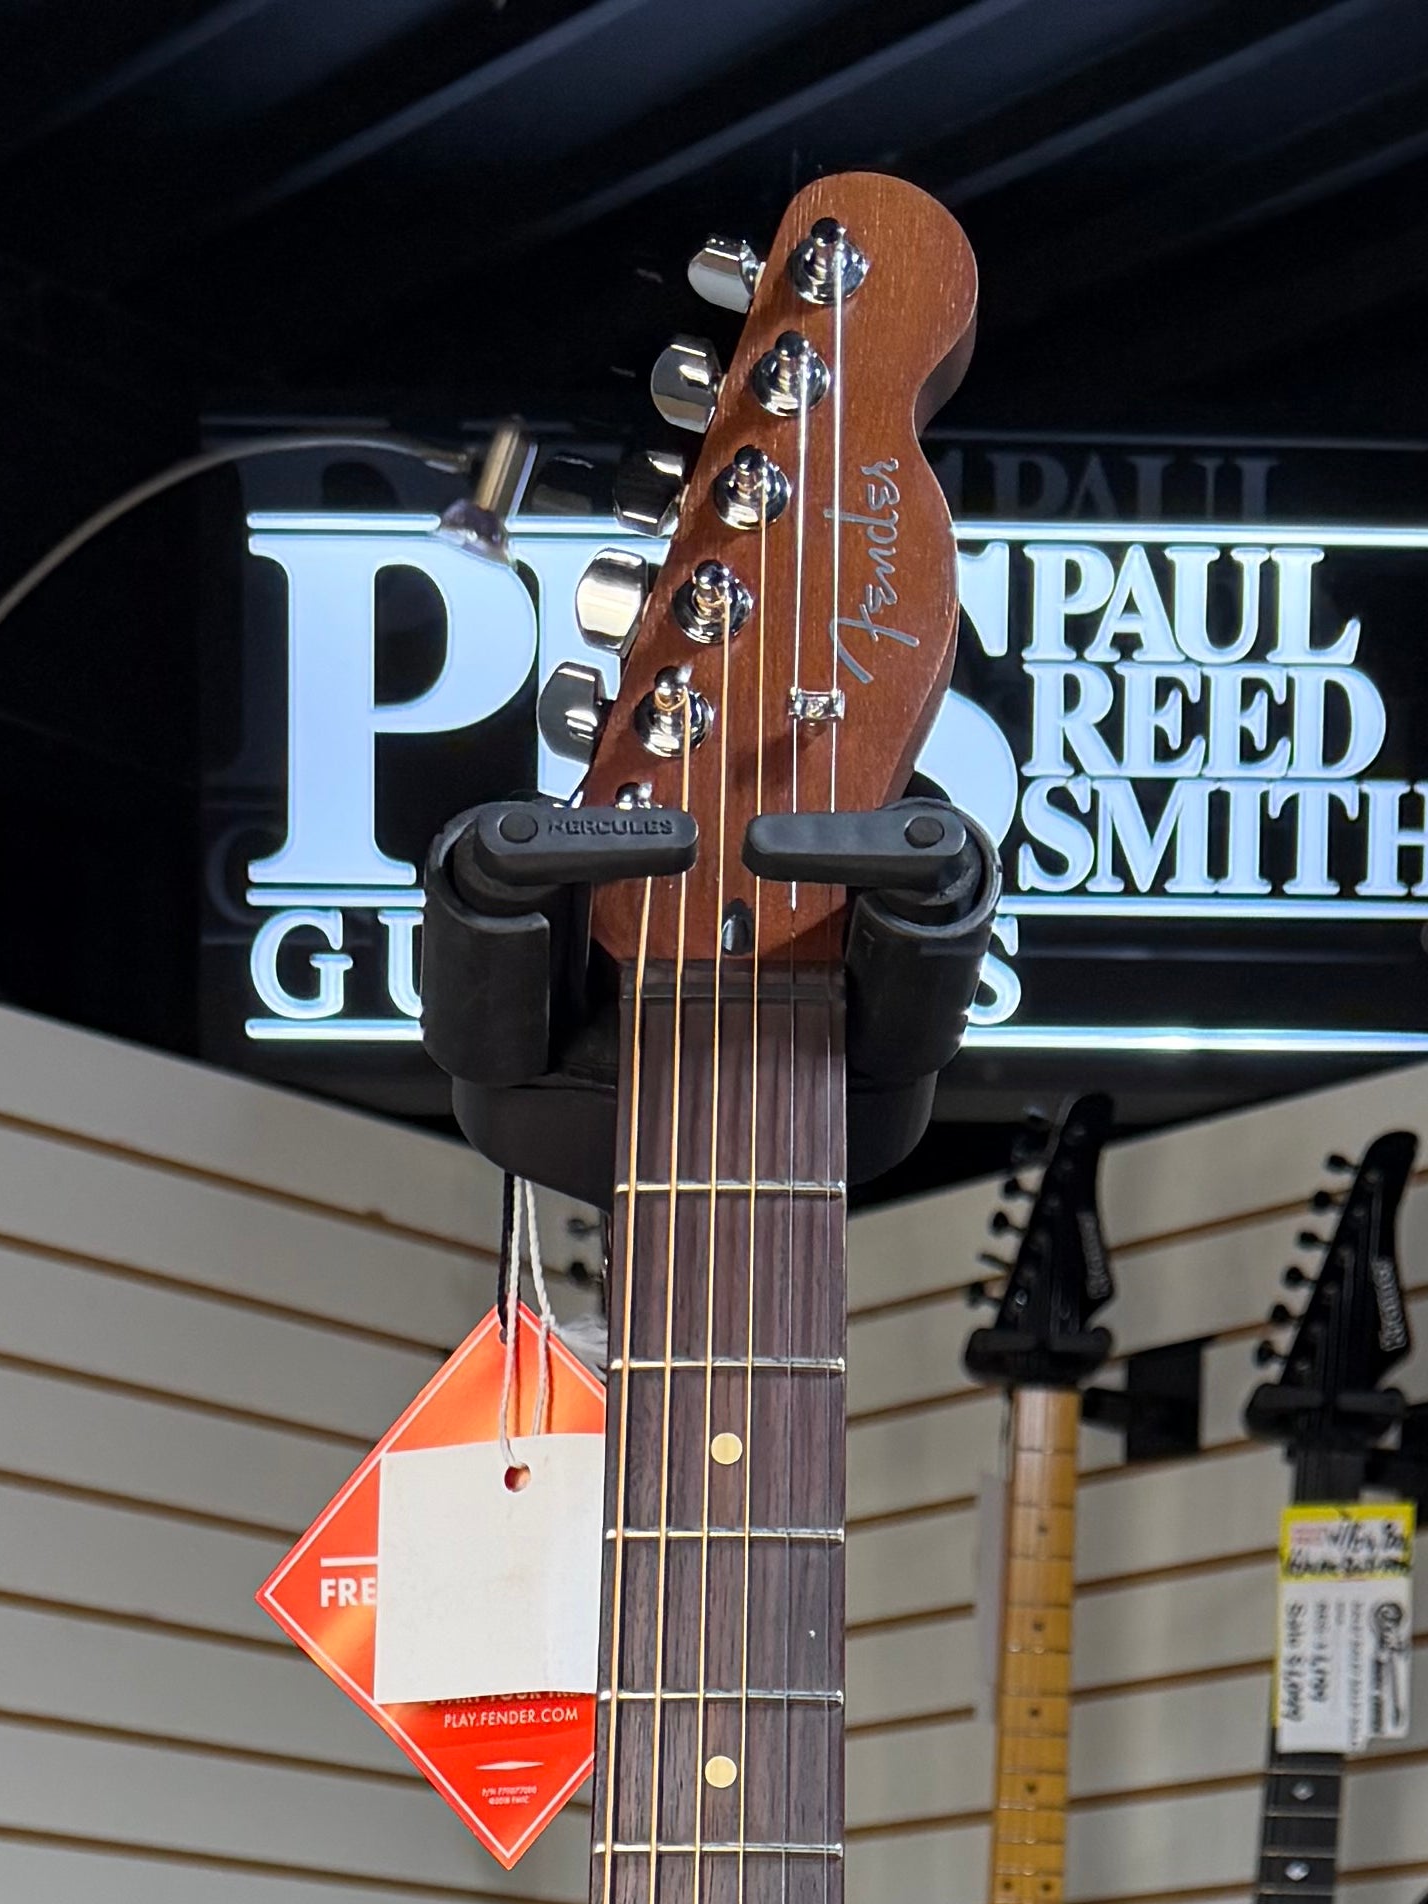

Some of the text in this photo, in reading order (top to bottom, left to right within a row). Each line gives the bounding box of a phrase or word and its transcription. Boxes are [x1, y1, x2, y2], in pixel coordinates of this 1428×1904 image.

[823, 457, 920, 684] Fender
[1020, 543, 1362, 665] PAUL
[1020, 663, 1390, 780] REED
[547, 818, 675, 836] HERCULES
[443, 1707, 579, 1729] PLAY.FENDER.COM
